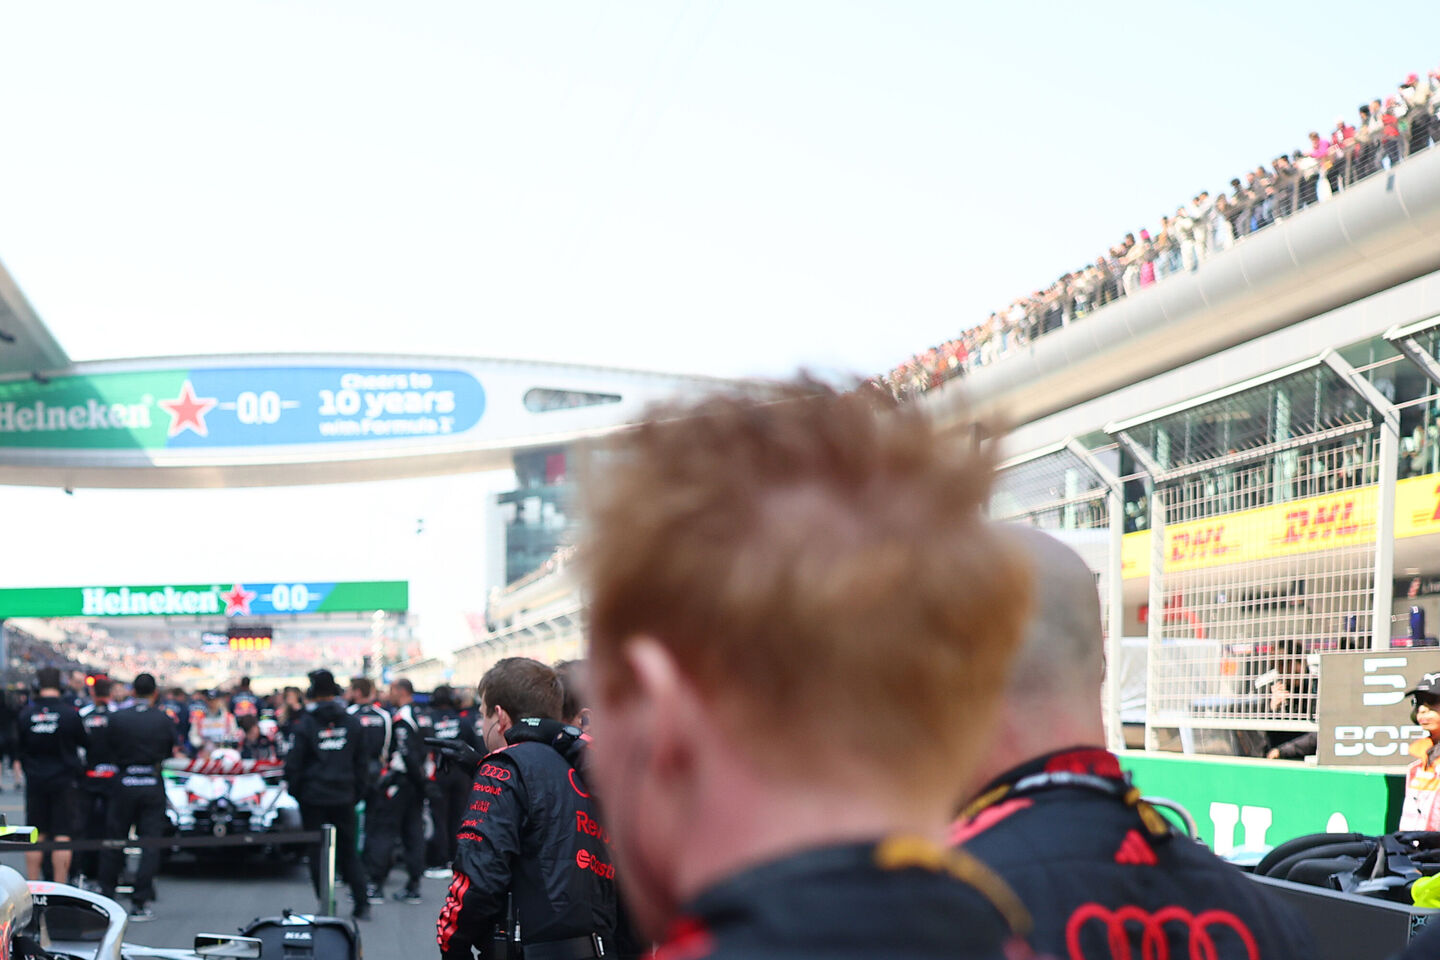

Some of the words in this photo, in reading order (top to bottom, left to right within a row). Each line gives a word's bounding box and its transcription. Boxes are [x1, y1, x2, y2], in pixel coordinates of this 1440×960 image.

[318, 389, 360, 416] 10
[364, 391, 455, 418] years
[1283, 502, 1358, 542] DHL
[1171, 526, 1229, 561] DHL
[82, 587, 219, 615] Heineken
[1362, 657, 1407, 706] 5
